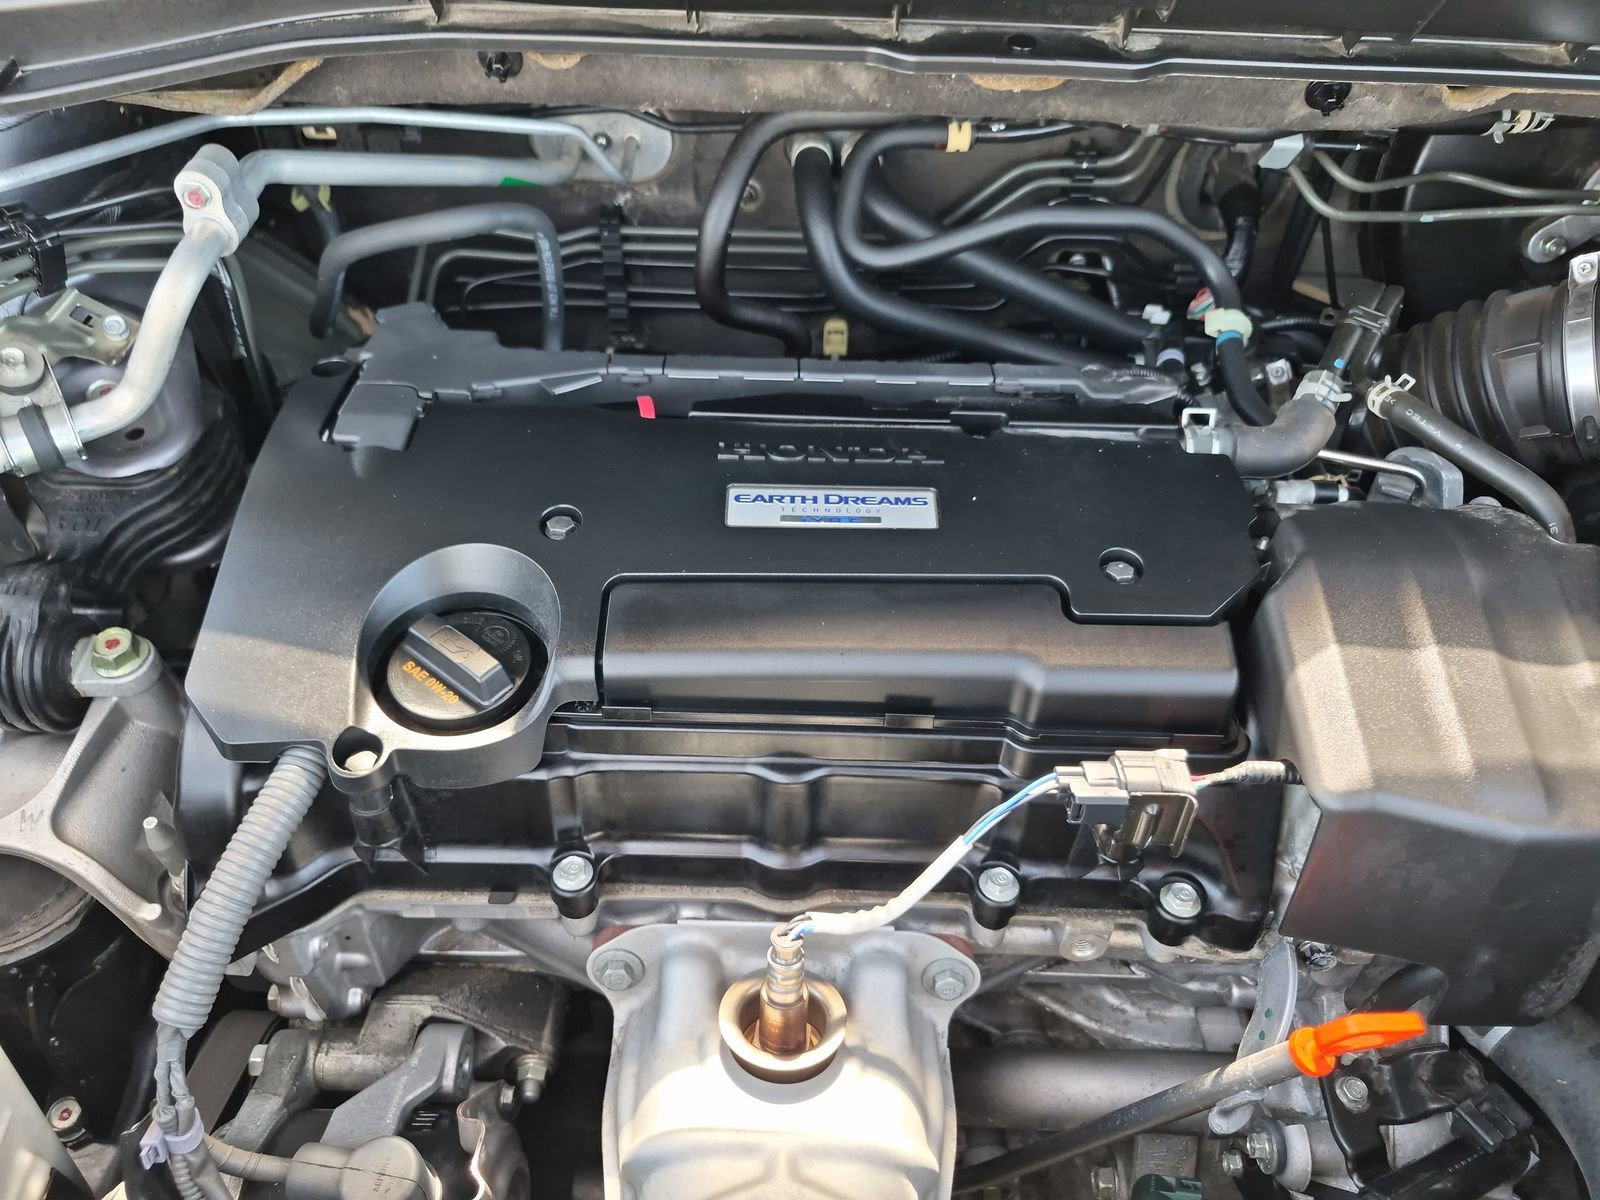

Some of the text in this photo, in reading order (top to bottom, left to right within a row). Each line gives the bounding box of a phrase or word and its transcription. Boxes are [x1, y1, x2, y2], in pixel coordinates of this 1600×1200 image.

[717, 441, 945, 464] HONDA
[733, 493, 929, 506] EARTH DREAMS
[401, 660, 429, 682] SAE
[424, 676, 461, 705] 0W-20
